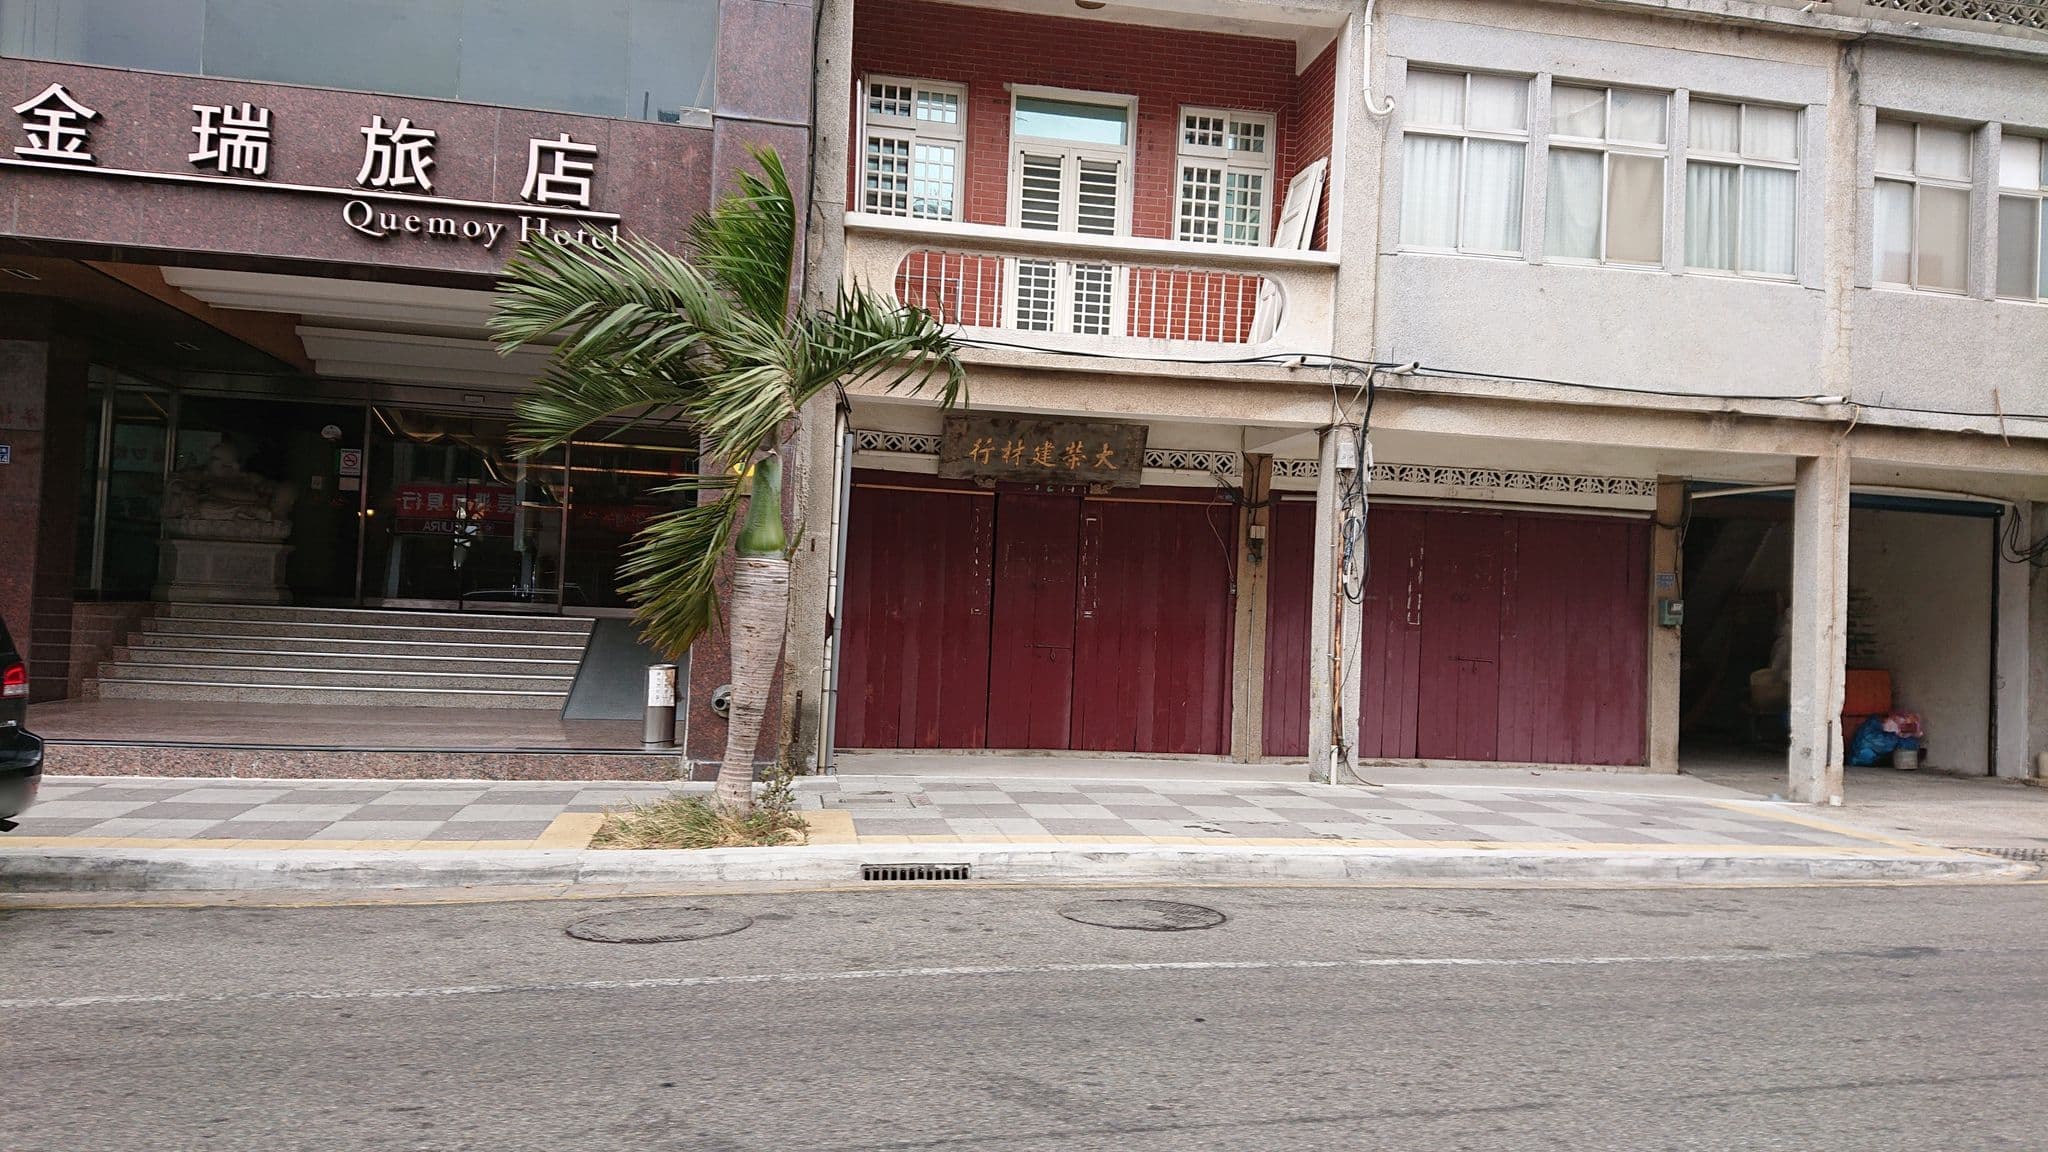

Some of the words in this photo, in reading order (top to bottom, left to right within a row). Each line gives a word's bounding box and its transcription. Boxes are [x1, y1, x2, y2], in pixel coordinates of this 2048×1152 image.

[12, 83, 598, 208] 金瑞旅店
[342, 200, 505, 250] Quemoy
